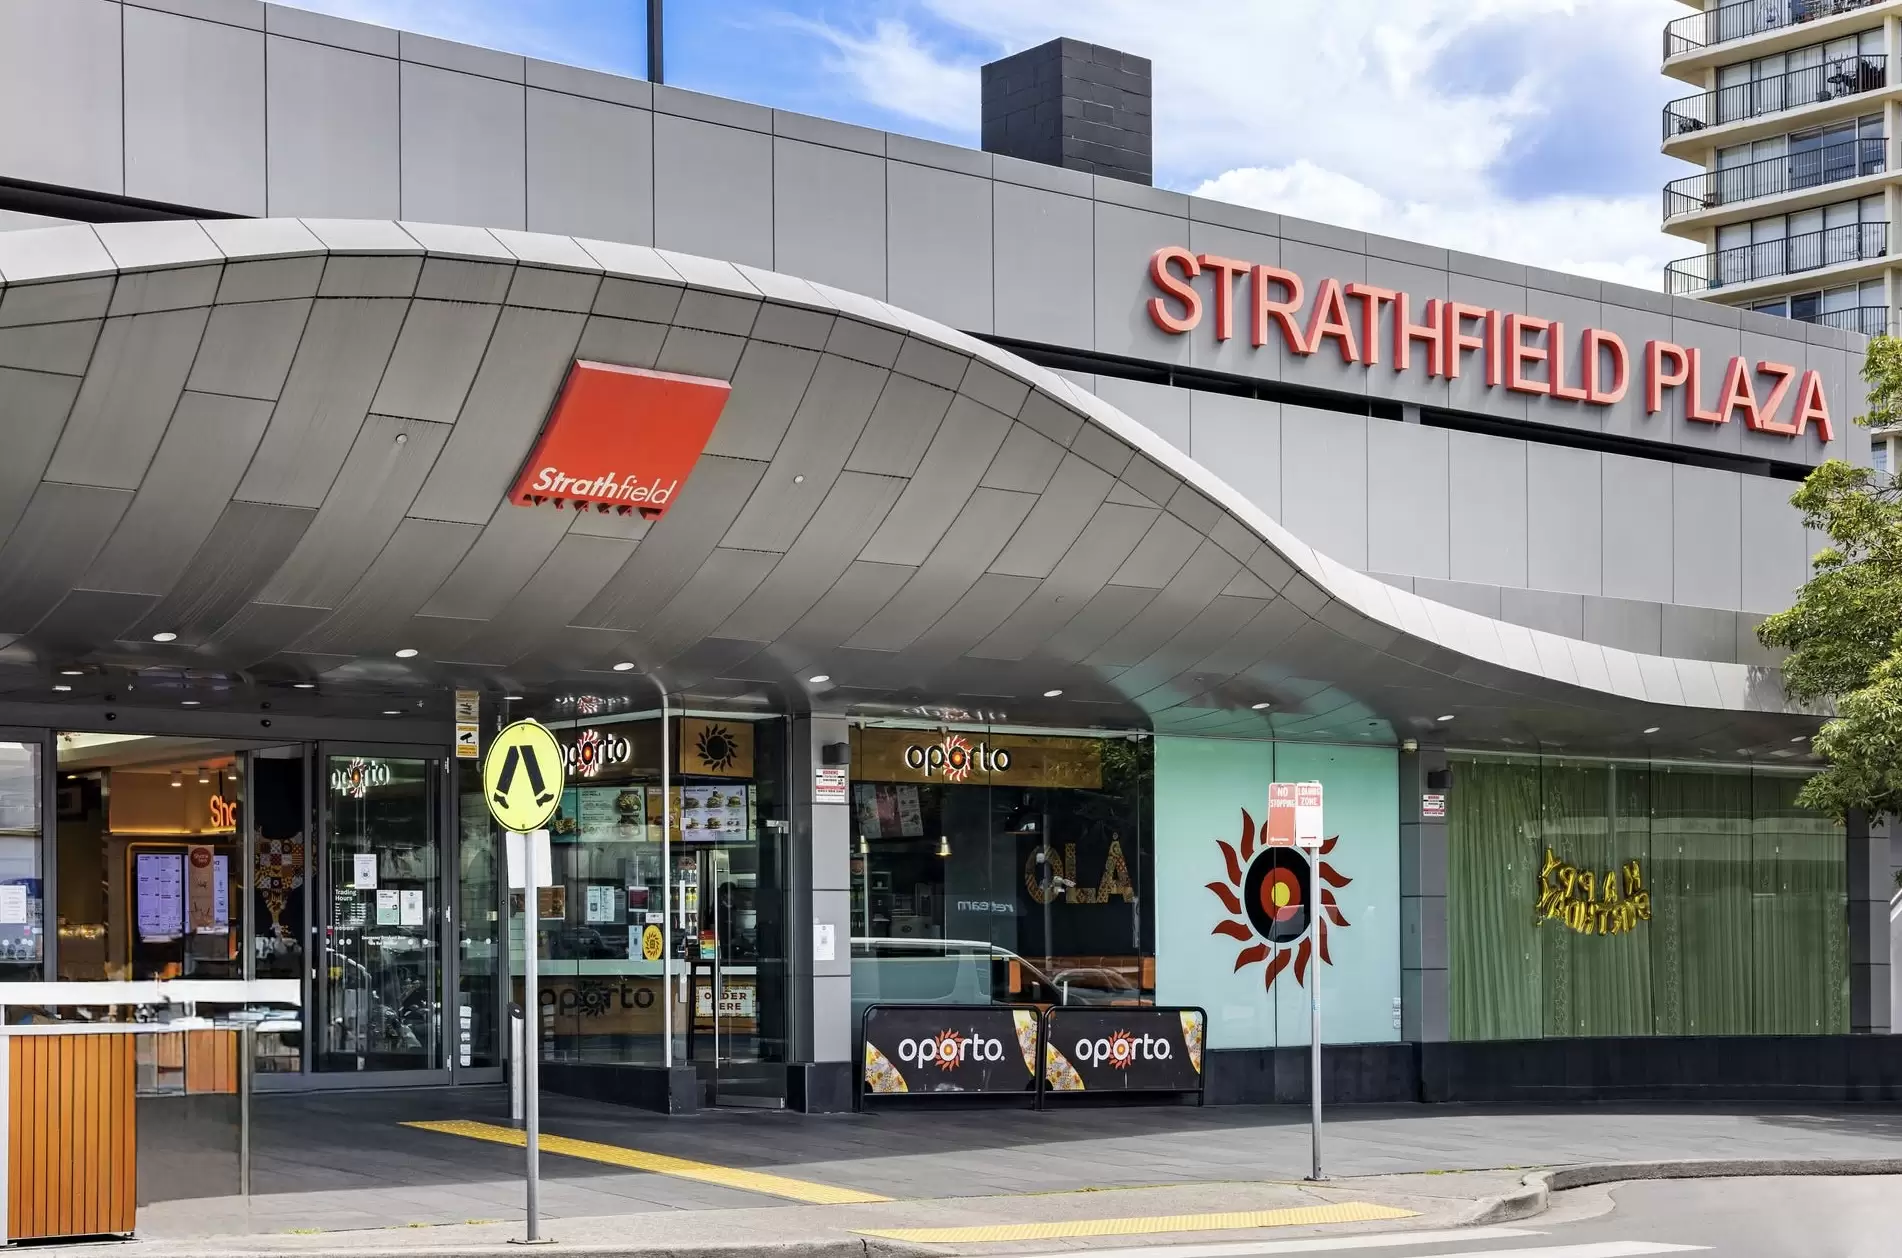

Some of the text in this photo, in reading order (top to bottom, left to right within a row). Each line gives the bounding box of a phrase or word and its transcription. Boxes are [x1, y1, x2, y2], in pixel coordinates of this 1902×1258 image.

[1148, 246, 1834, 442] STRATHFIELD PLAZA
[532, 467, 678, 504] Strathfield
[905, 740, 1012, 777] oporto
[1277, 786, 1289, 797] NO
[1301, 797, 1318, 805] ZONE
[335, 889, 357, 897] Trading
[537, 983, 655, 1016] oporto
[704, 992, 747, 1000] ODER
